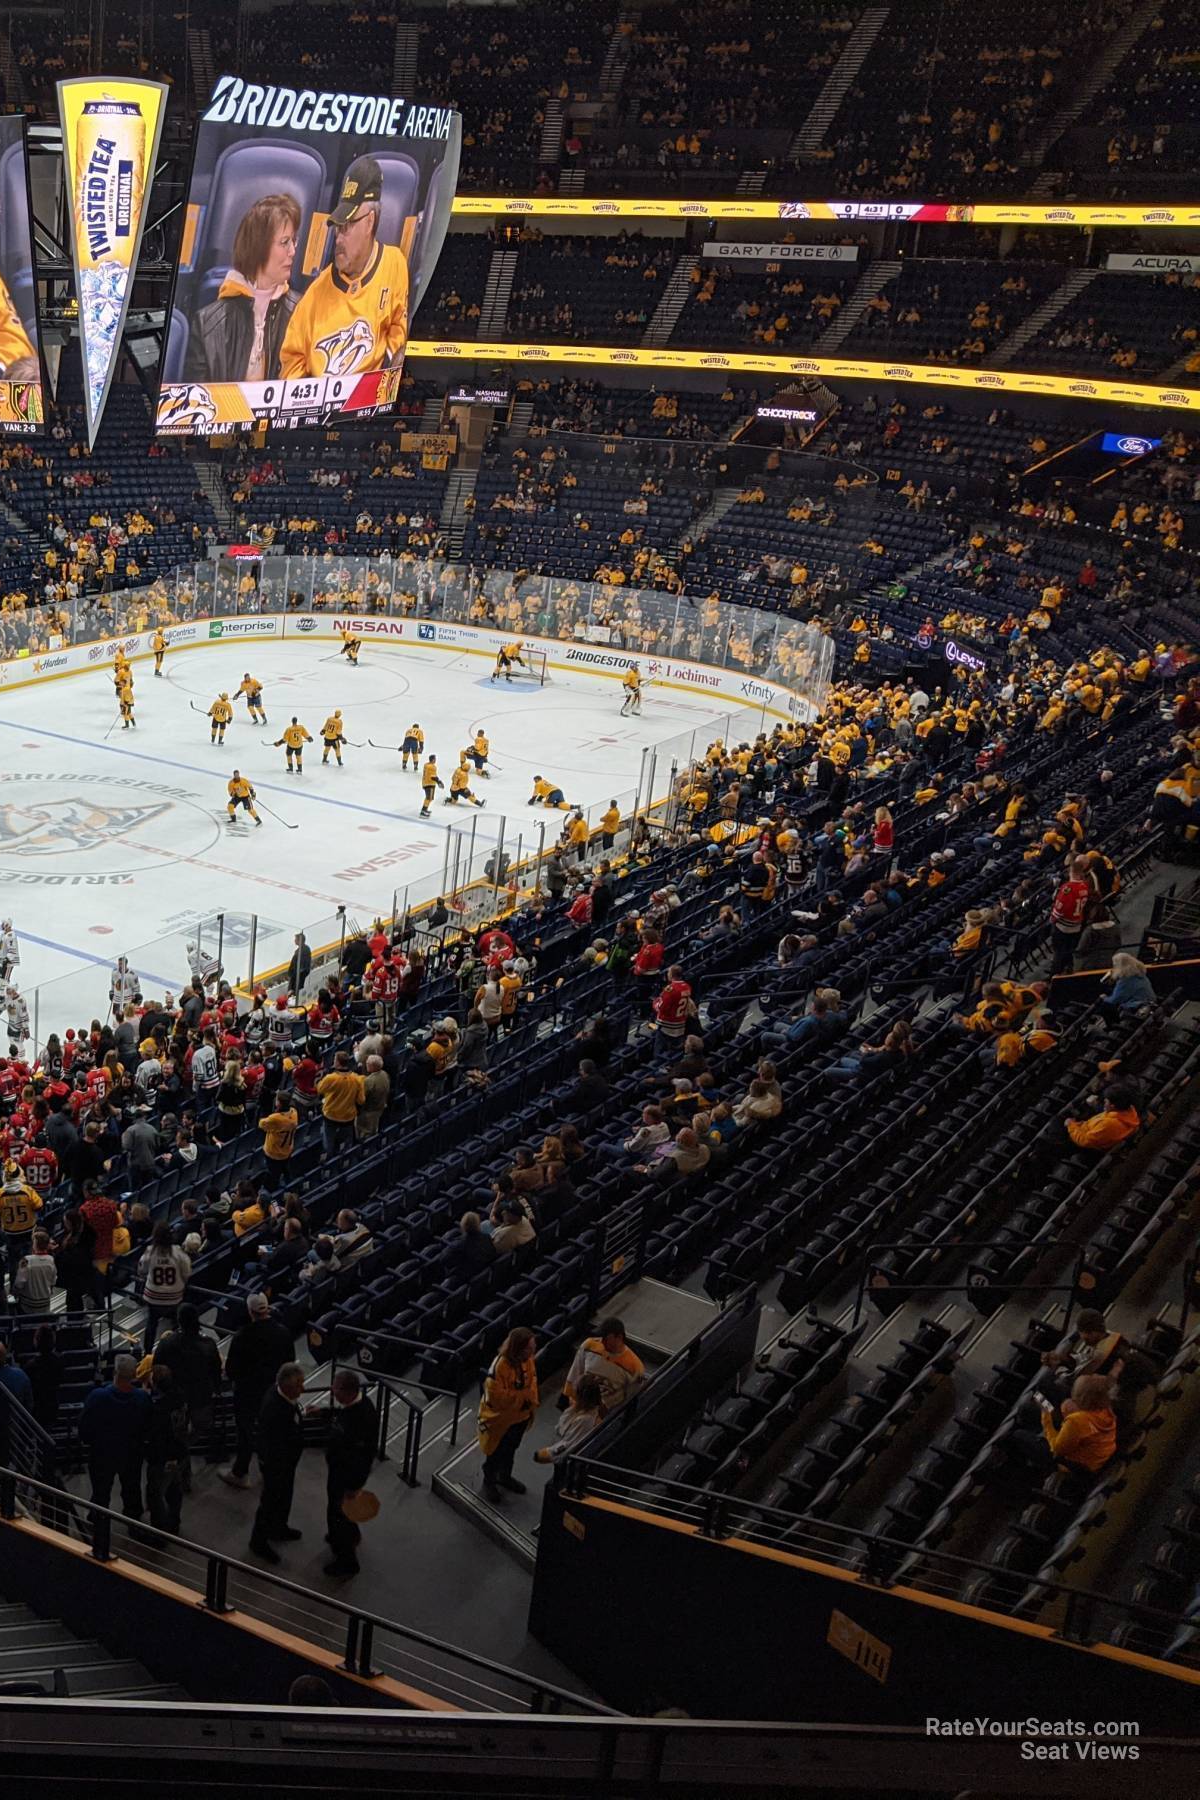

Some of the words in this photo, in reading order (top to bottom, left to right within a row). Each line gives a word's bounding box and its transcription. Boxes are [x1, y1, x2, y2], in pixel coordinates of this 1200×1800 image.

[202, 75, 404, 136] BRIDGESTONE
[402, 106, 451, 140] ARENA
[88, 137, 116, 175] TEA
[118, 172, 131, 226] ORIGINAL
[845, 205, 852, 213] 0
[88, 175, 111, 262] TWISTED
[720, 246, 763, 255] GARY
[770, 247, 825, 257] FORCE
[1132, 258, 1192, 269] ACURA
[264, 387, 274, 404] 0
[291, 385, 318, 399] 4:31
[333, 381, 342, 397] 0
[270, 409, 276, 418] 0
[4, 423, 20, 432] VAN:
[22, 424, 36, 432] 2-8
[198, 423, 233, 434] NCAAF
[241, 422, 252, 431] UK
[272, 418, 287, 428] VAN
[305, 416, 318, 425] FINAL
[327, 432, 340, 440] 102
[886, 469, 900, 480] 120
[213, 621, 274, 633] enterprise
[333, 620, 403, 634] NISSAN
[666, 664, 722, 686] Lochinvar
[741, 681, 775, 703] xfinity
[1, 773, 203, 799] BRIDGESTONE
[332, 840, 438, 881] NISSAN
[386, 978, 399, 994] 19
[26, 1166, 50, 1185] 88
[6, 1205, 28, 1224] 35
[154, 1267, 176, 1285] 88
[857, 1641, 886, 1678] 114
